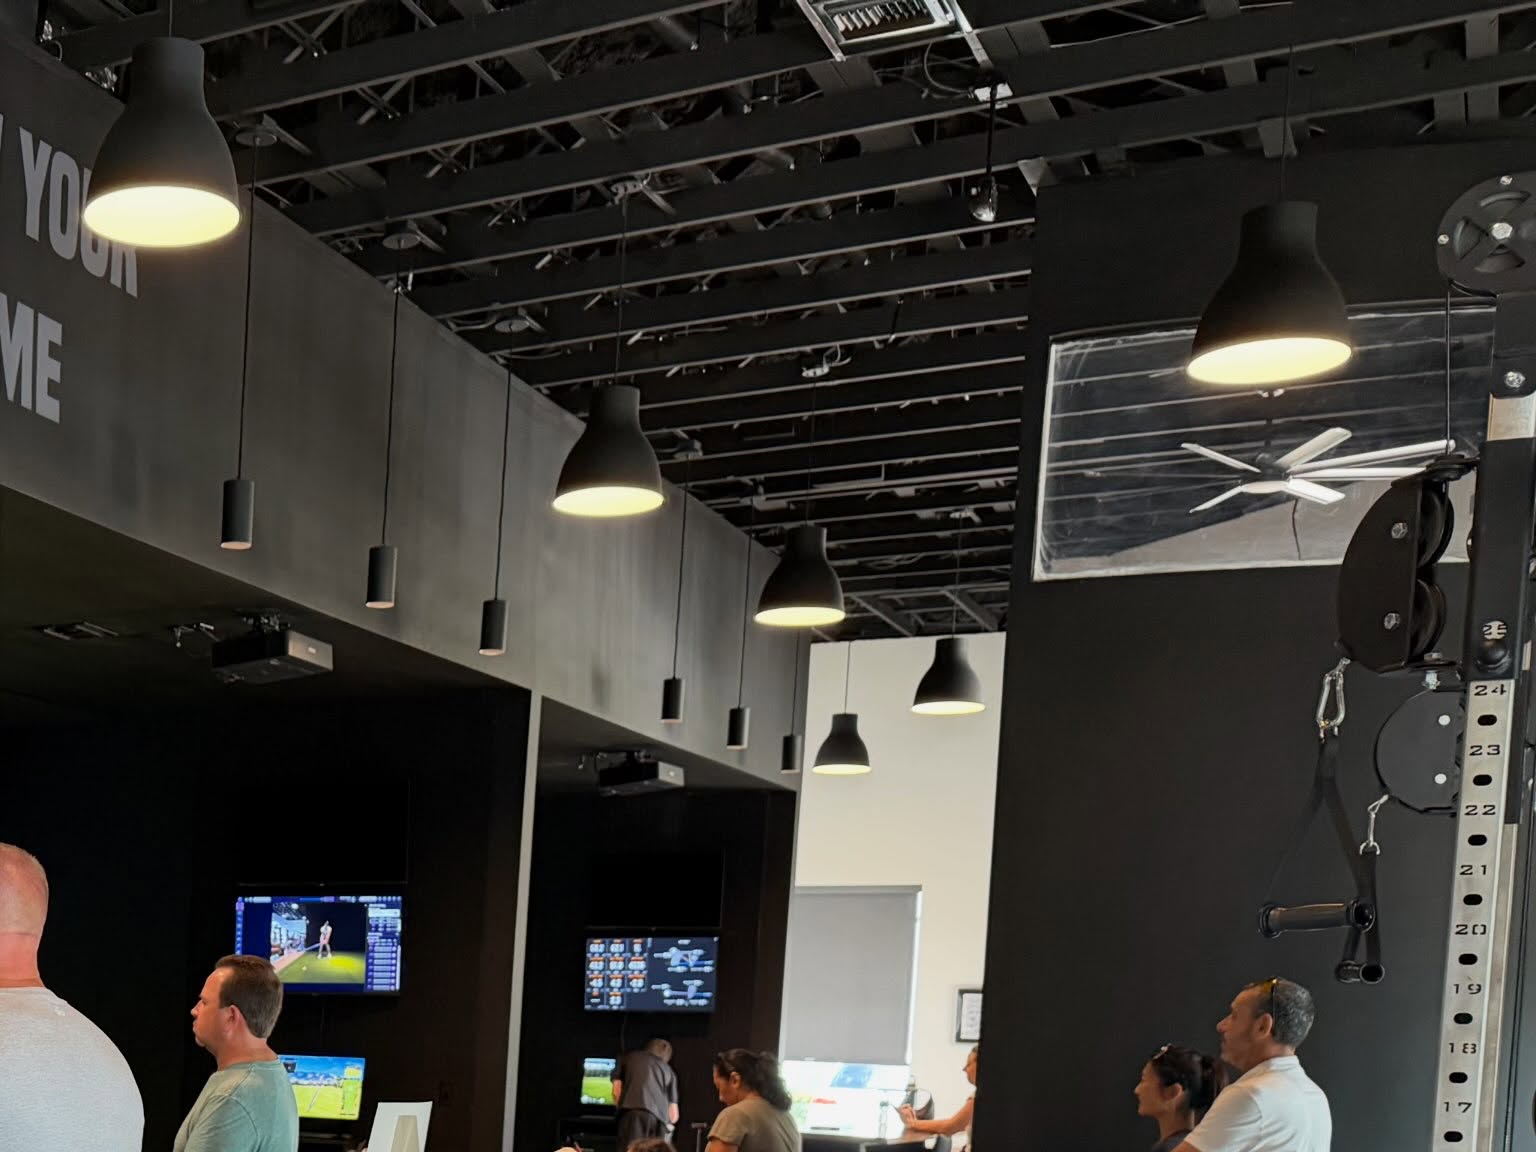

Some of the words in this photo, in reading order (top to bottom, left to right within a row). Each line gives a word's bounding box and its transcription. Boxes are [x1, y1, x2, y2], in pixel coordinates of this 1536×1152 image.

[1474, 684, 1507, 696] 24
[1468, 744, 1501, 757] 23
[1463, 804, 1496, 817] 22
[1459, 864, 1487, 876] 21
[1454, 923, 1487, 936] 20
[1453, 983, 1482, 995] 19
[1448, 1042, 1477, 1055] 18
[1443, 1101, 1473, 1114] 17
